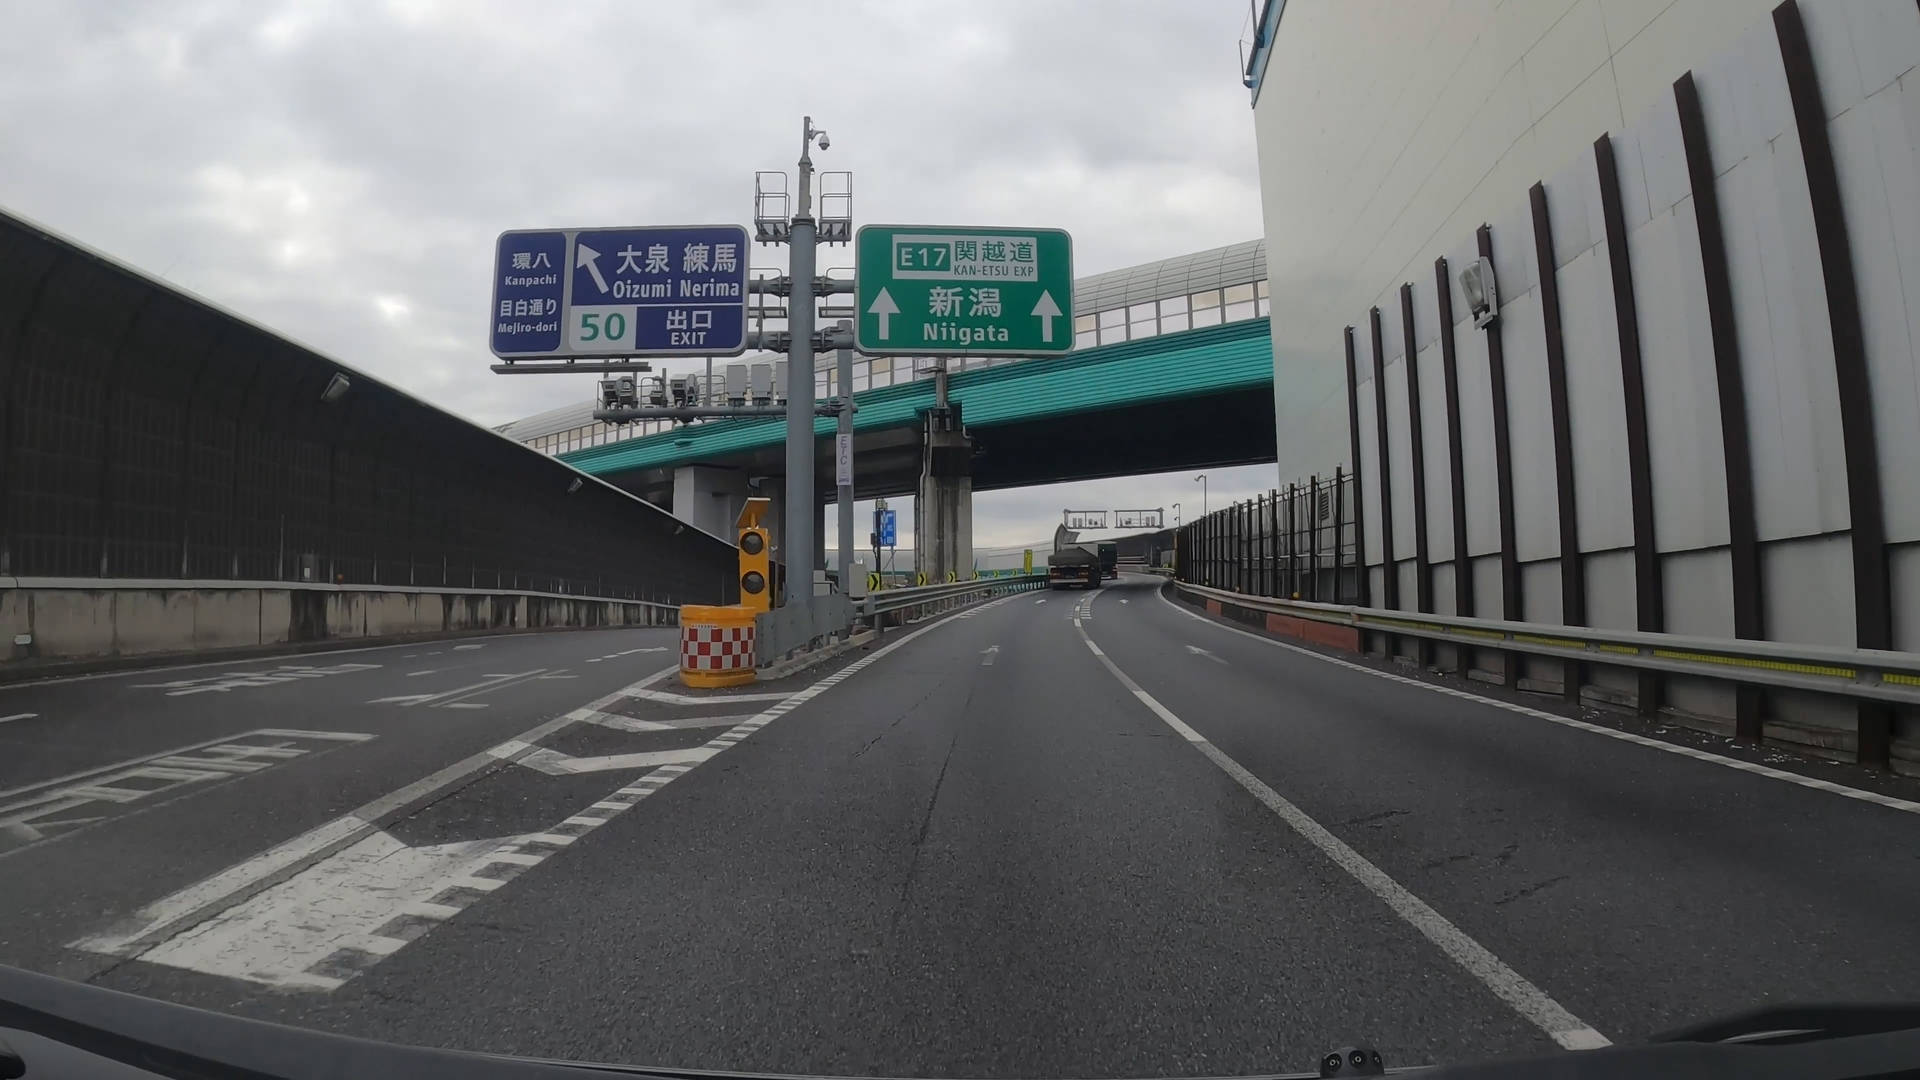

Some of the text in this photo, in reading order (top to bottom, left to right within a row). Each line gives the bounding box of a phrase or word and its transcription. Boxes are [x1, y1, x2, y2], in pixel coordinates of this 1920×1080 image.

[512, 252, 551, 269] 環八
[616, 242, 738, 274] 大泉 練馬
[901, 247, 946, 267] E17
[954, 240, 1034, 263] 関越道
[505, 274, 557, 287] Kanpachi
[953, 264, 1034, 278] KAN-ETSU EXP
[613, 278, 739, 299] Oizumi Nerima
[500, 298, 557, 317] 目白通り
[929, 286, 1002, 318] 新潟
[498, 321, 557, 335] Mejiro-dori
[580, 313, 626, 341] 50
[666, 310, 712, 330] 出口
[671, 332, 706, 346] EXIT
[924, 322, 1009, 345] Niigata
